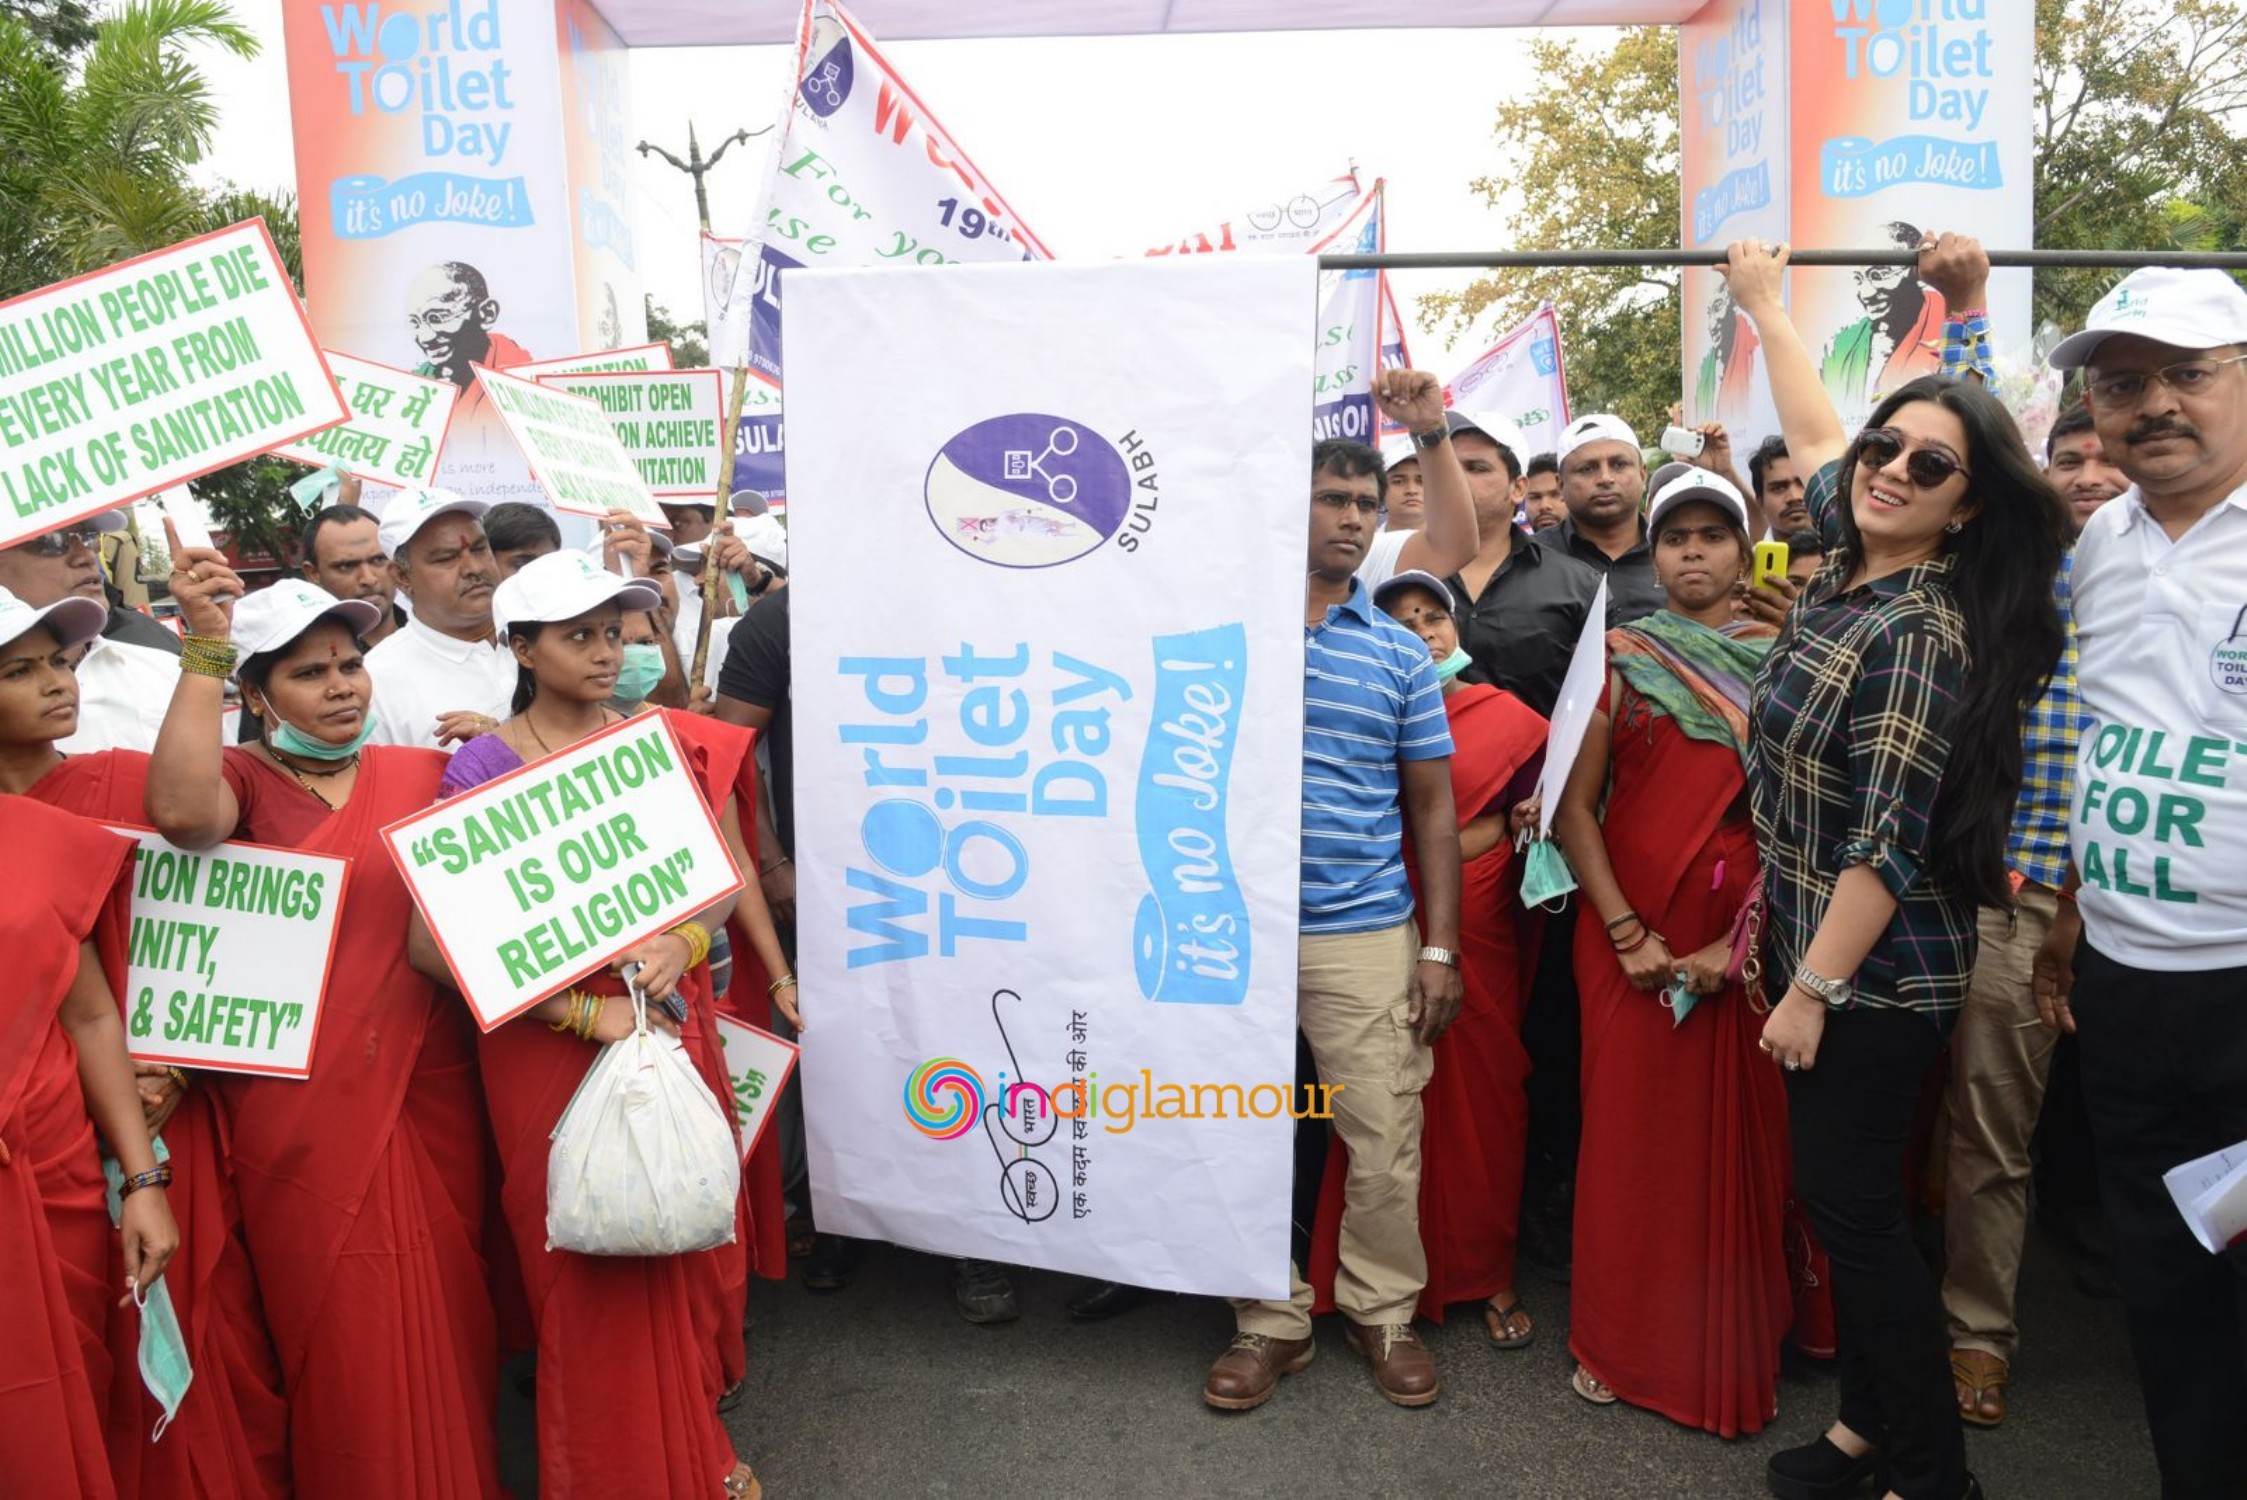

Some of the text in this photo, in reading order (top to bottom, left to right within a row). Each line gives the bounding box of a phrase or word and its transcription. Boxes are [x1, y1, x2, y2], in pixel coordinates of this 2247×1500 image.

[321, 0, 502, 61] World
[1834, 24, 1994, 79] Toilet
[336, 55, 514, 116] Toilet
[1909, 80, 1989, 131] Day
[421, 114, 512, 167] Day
[1728, 110, 1763, 158] Day
[778, 146, 872, 220] For
[1833, 143, 1987, 192] it's no Joke!
[346, 180, 516, 234] it's no Joke!
[99, 260, 218, 338] PEOPLE
[210, 244, 269, 299] DIE
[0, 316, 262, 448] EVERY YEAR FROM
[352, 382, 438, 428] घर में
[648, 383, 692, 411] OPEN
[1, 371, 305, 518] LACK OF SANITATION
[395, 435, 432, 478] हो
[645, 420, 715, 448] ACHIEVE
[1117, 429, 1158, 553] SULABH
[2217, 650, 2247, 661] WOR
[2217, 662, 2247, 673] TOIL
[1031, 651, 1133, 818] Day
[2085, 723, 2247, 788] OILE
[838, 656, 944, 970] World
[933, 640, 1030, 958] Toilet
[1152, 659, 1240, 981] it's no Joke!
[2081, 779, 2205, 848] FOR
[204, 858, 324, 921] BRINGS
[504, 812, 649, 912] IS OUR
[2083, 841, 2198, 904] ALL
[130, 986, 154, 1038] &
[1071, 1145, 1091, 1187] कदम
[1071, 1191, 1091, 1219] एक
